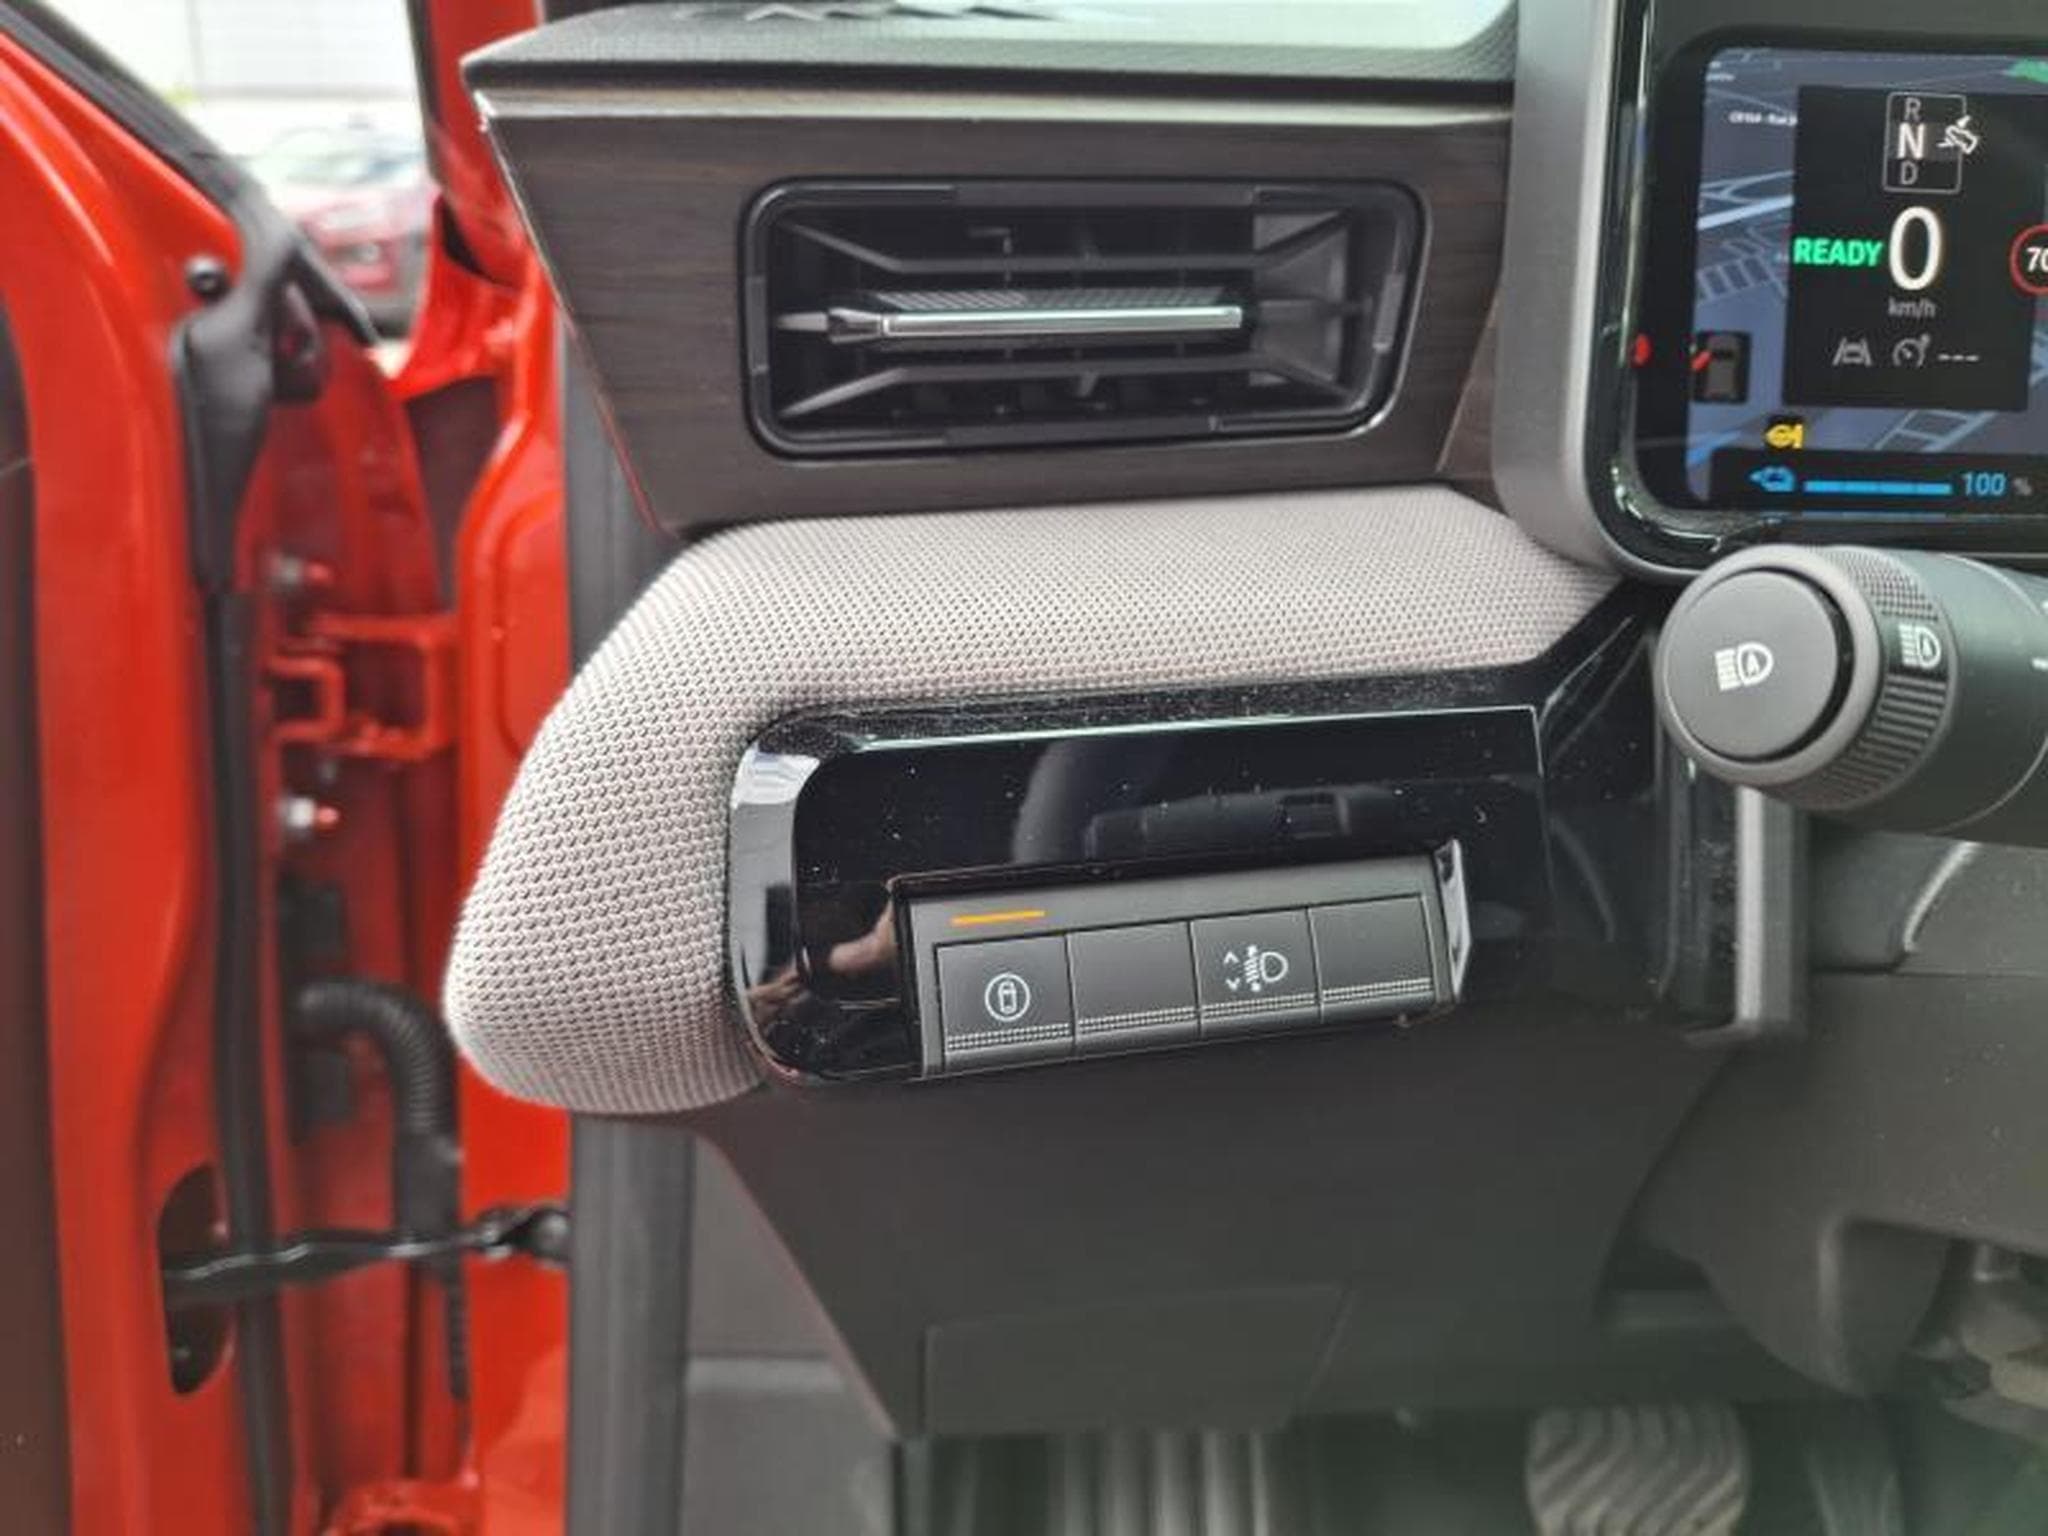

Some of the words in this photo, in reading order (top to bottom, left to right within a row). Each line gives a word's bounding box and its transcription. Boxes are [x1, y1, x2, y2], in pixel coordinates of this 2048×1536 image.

[1903, 97, 1922, 121] R
[1896, 122, 1925, 160] N
[1899, 160, 1919, 186] D
[1792, 237, 1883, 268] READY
[1889, 205, 1942, 291] 0
[1887, 297, 1937, 318] km/h
[1960, 471, 2007, 497] 100
